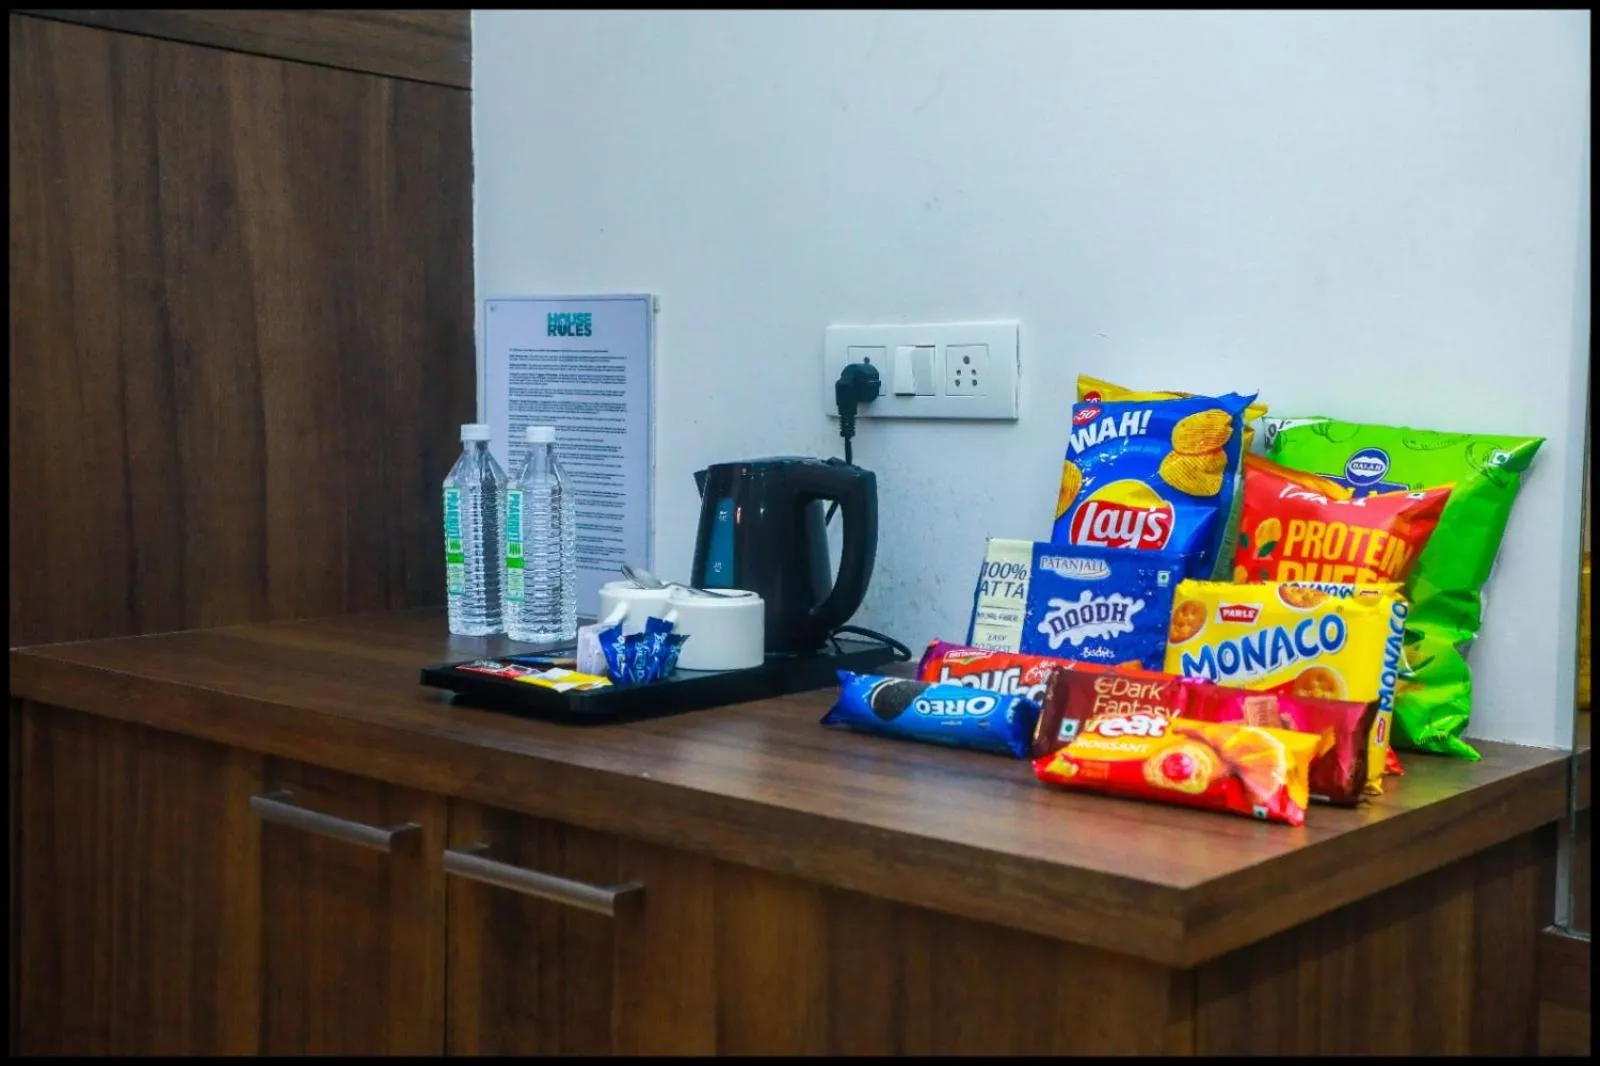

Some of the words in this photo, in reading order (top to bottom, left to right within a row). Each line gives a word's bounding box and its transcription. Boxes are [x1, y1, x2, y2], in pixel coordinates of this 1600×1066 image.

[548, 312, 592, 325] HOUSE
[548, 324, 592, 336] RULES
[1070, 409, 1153, 454] WAH!
[1076, 501, 1168, 548] Lay's
[1283, 519, 1413, 574] PROTEIN
[981, 561, 1027, 580] 100%
[979, 580, 1025, 599] ATTA
[1049, 601, 1128, 635] DOODH
[1181, 614, 1345, 683] MONACO
[1378, 601, 1408, 712] MONACO
[915, 696, 996, 716] OREO
